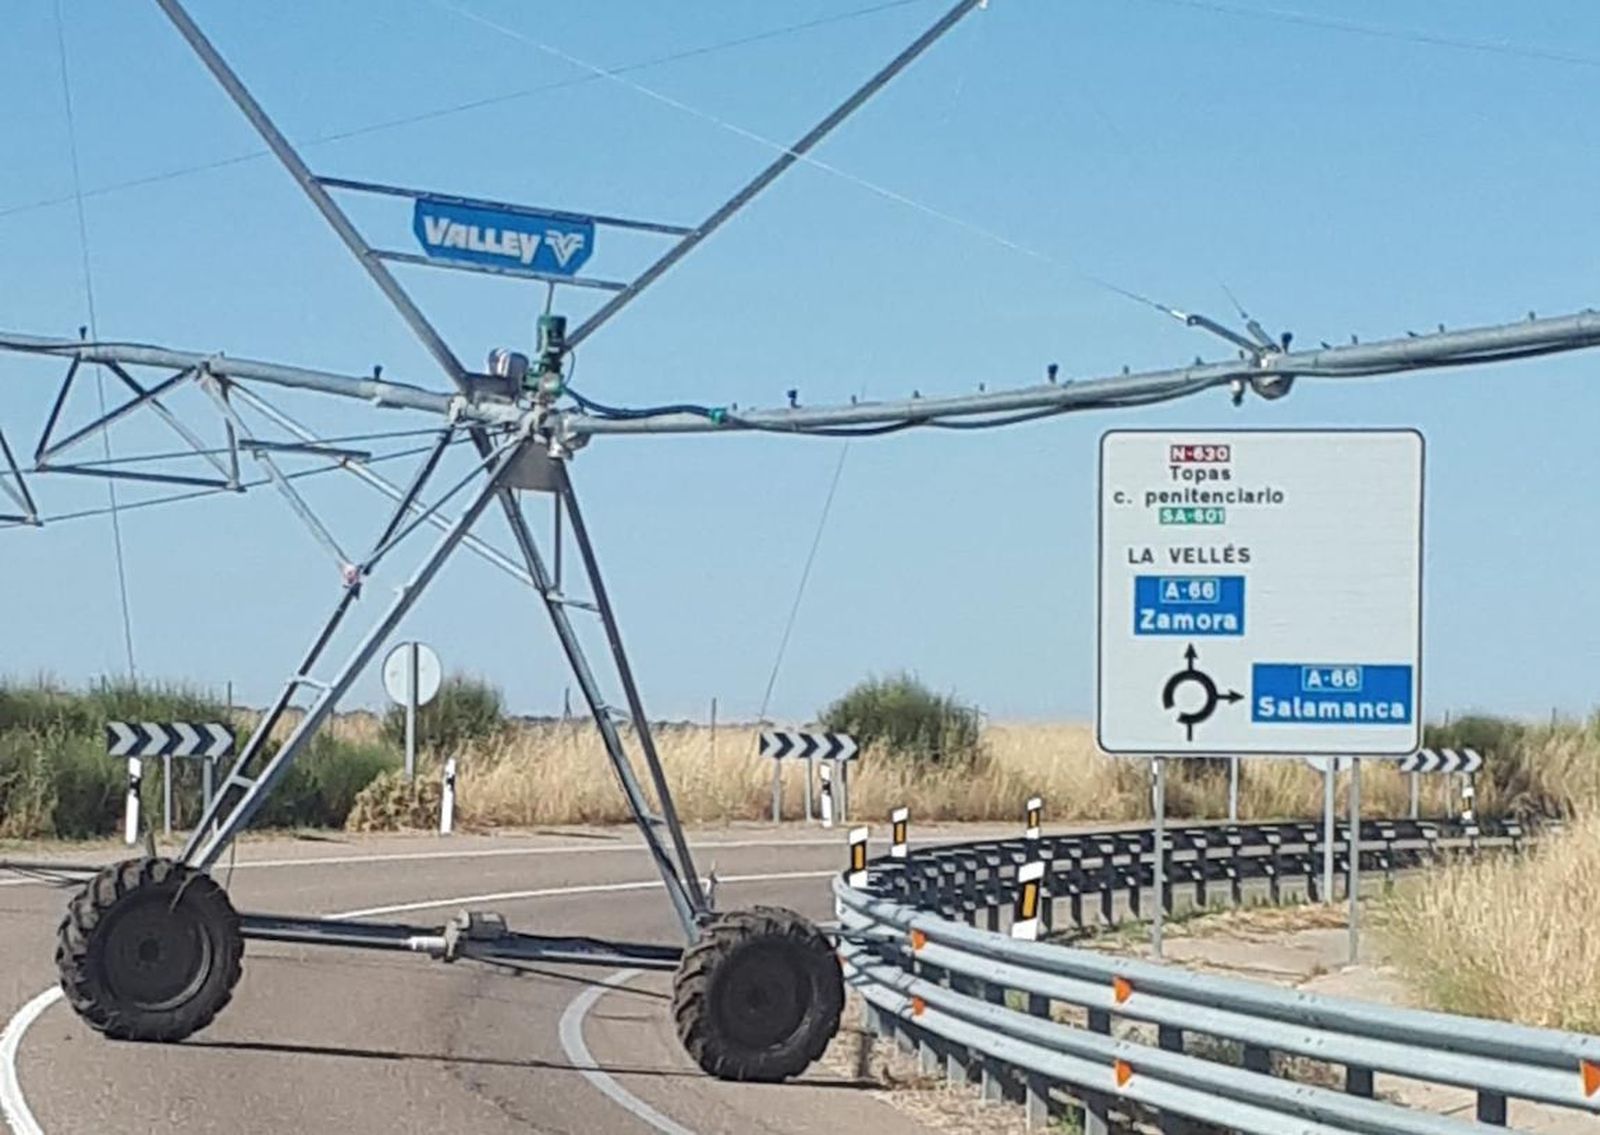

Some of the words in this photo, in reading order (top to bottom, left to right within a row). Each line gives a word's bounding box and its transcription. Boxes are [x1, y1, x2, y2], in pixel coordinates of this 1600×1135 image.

[423, 215, 541, 265] VALLEY
[1170, 465, 1231, 484] Topas
[1113, 490, 1133, 504] c.
[1145, 487, 1284, 507] penitenciario
[1128, 548, 1154, 564] LA
[1169, 544, 1251, 564] VELLÉS
[1140, 608, 1238, 630] Zamora
[1258, 696, 1406, 718] Salamanca
